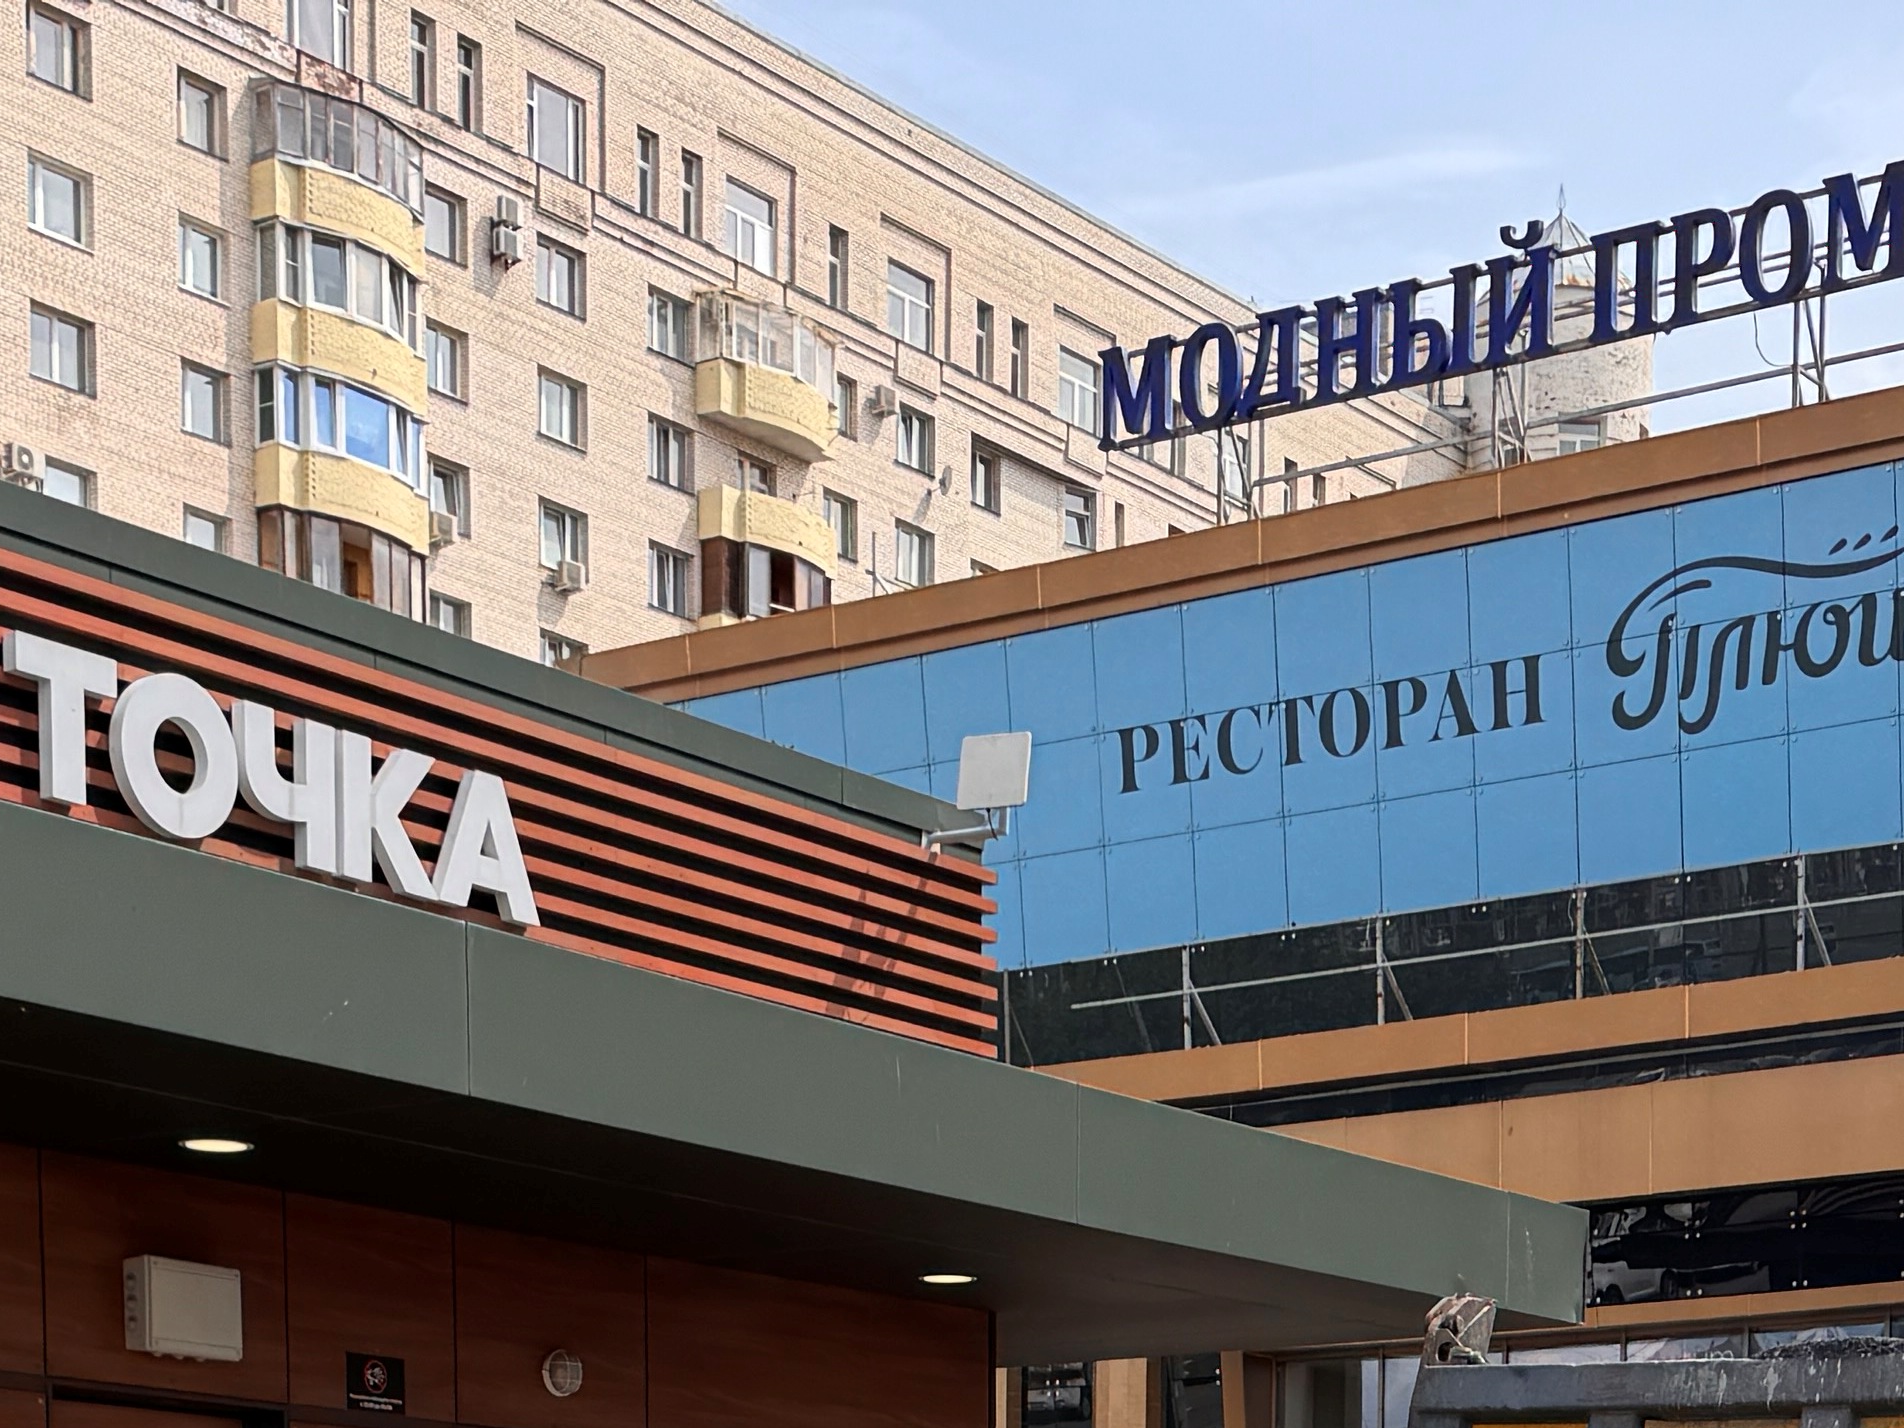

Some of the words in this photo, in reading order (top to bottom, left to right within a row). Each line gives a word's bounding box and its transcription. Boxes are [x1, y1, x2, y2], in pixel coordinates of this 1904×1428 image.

[1098, 220, 1557, 452] МОДНЫЙ
[1, 629, 541, 928] ТОЧКА
[1117, 652, 1543, 796] РЕСТОРАН
